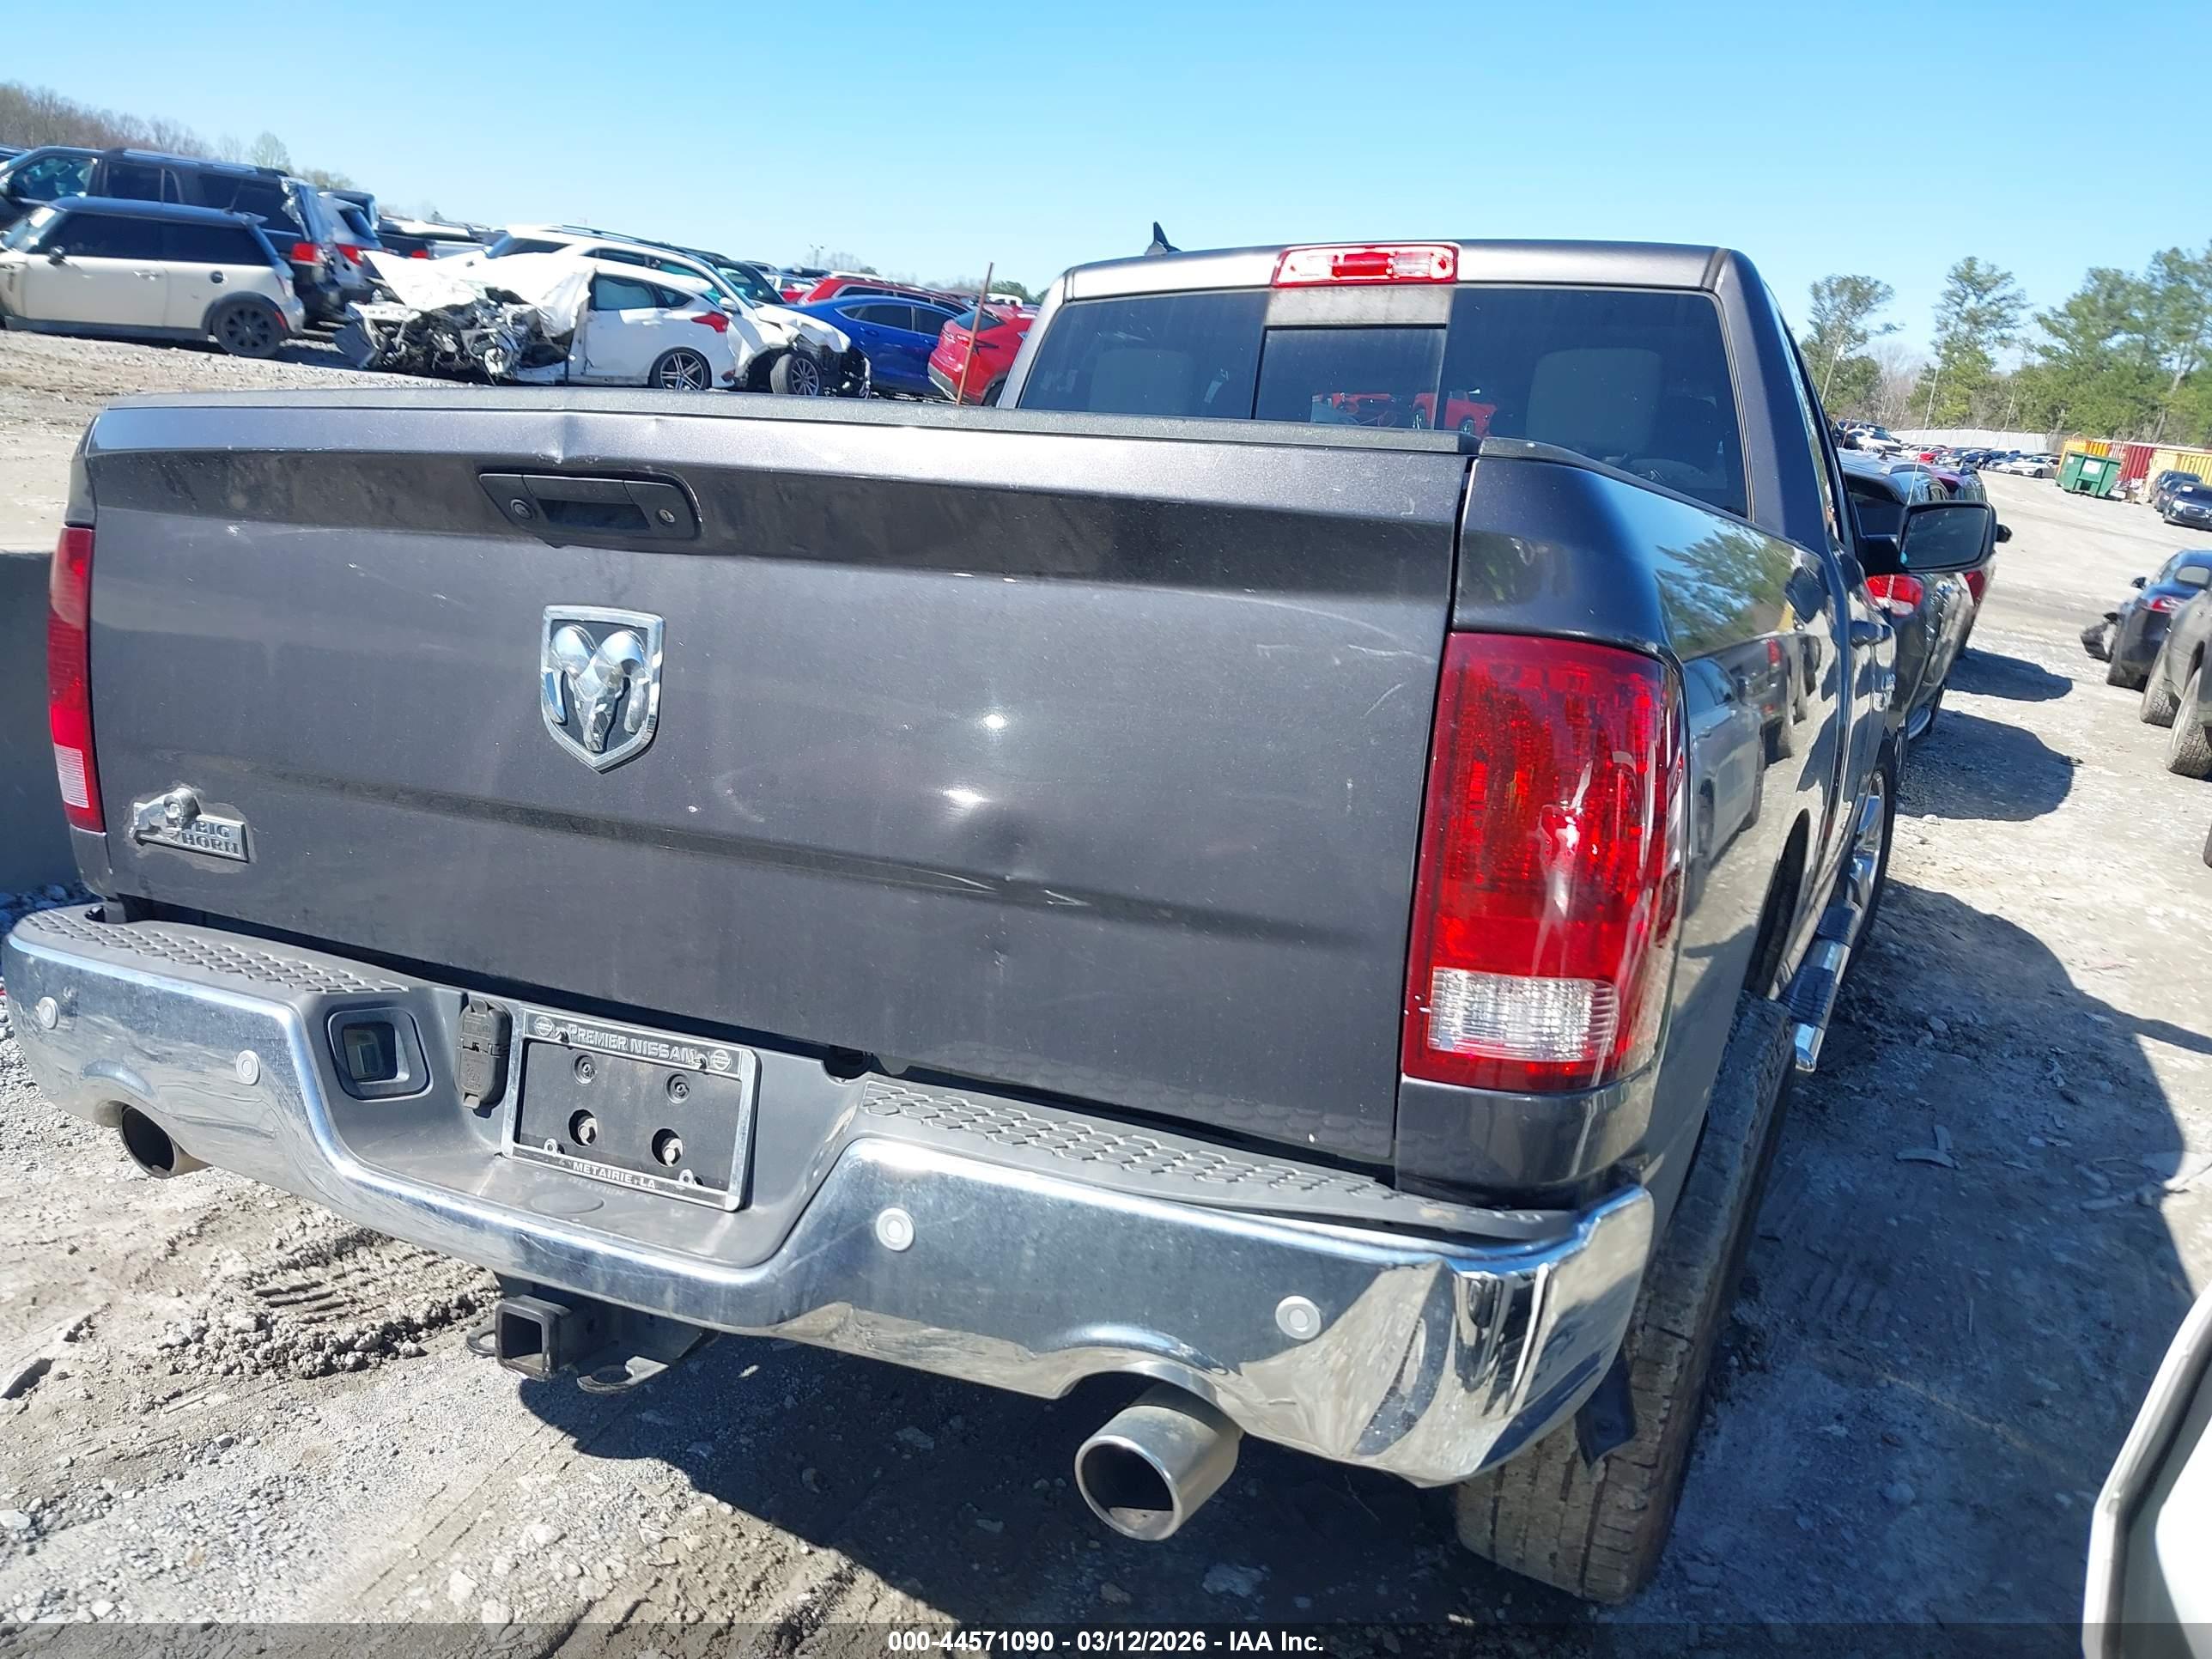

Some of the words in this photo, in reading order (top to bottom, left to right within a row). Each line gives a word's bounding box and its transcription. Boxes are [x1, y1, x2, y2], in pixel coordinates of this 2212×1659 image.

[196, 821, 230, 838] BIG
[182, 833, 239, 854] HORN
[568, 1024, 628, 1050] PREMIER
[629, 1038, 695, 1064] NISSAN
[640, 1177, 656, 1189] LA
